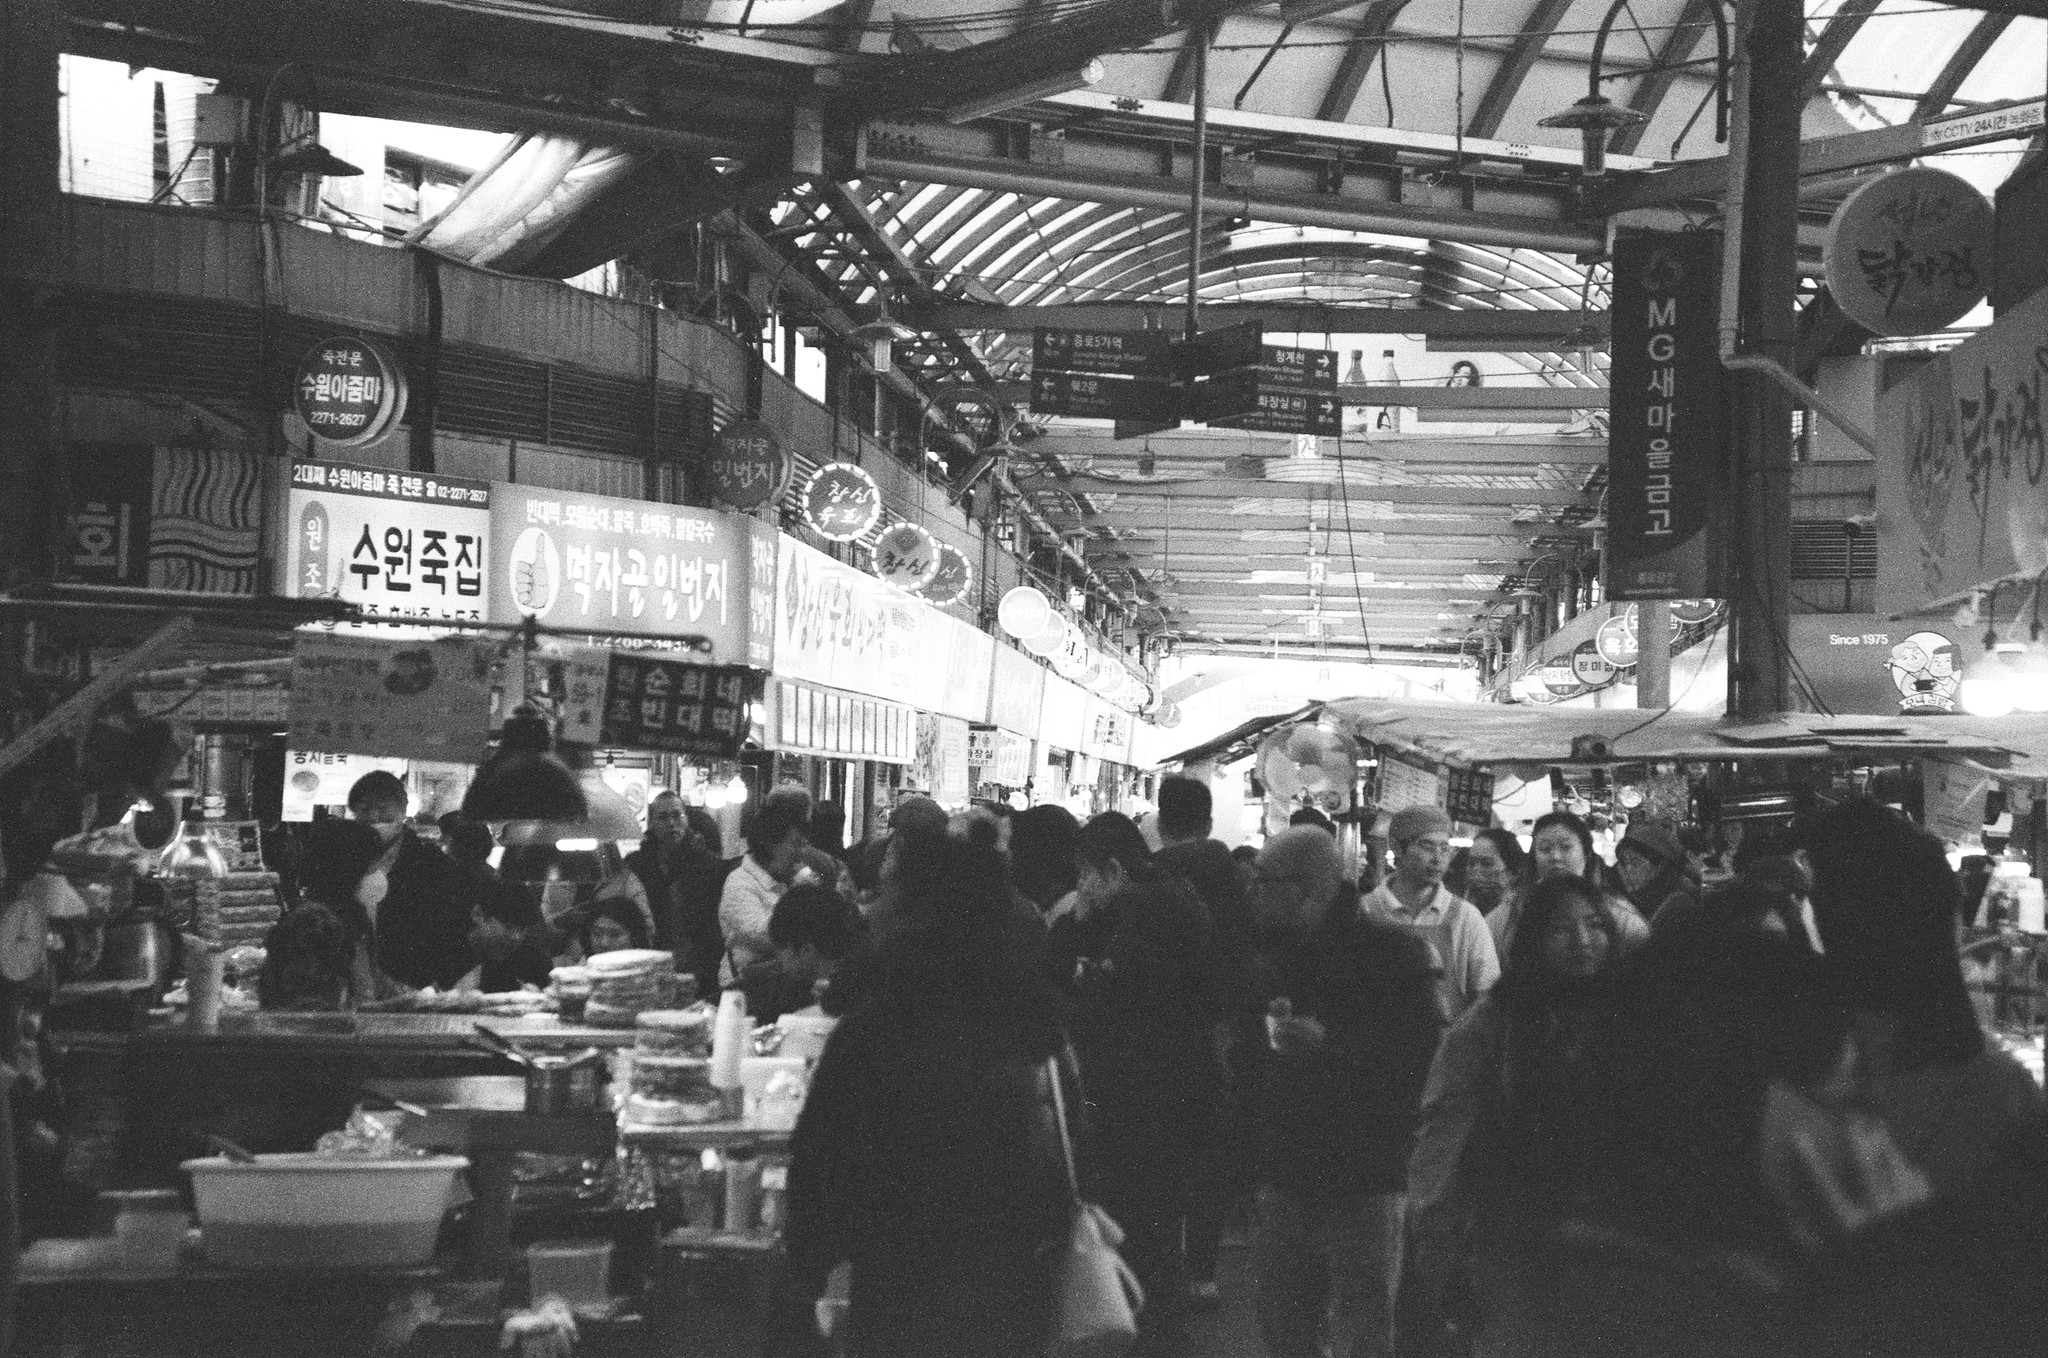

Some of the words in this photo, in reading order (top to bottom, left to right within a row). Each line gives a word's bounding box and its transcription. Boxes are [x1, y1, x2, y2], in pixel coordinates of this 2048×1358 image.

[322, 349, 363, 366] 죽전문
[301, 372, 380, 404] 수원아줌마
[311, 411, 366, 426] 2271-2627
[293, 464, 326, 486] 2대째
[327, 467, 386, 493] 수원아줌마
[304, 515, 323, 589] 원조
[349, 523, 483, 597] 수원죽집
[1829, 633, 1860, 646] Since
[1862, 633, 1888, 646] 1975
